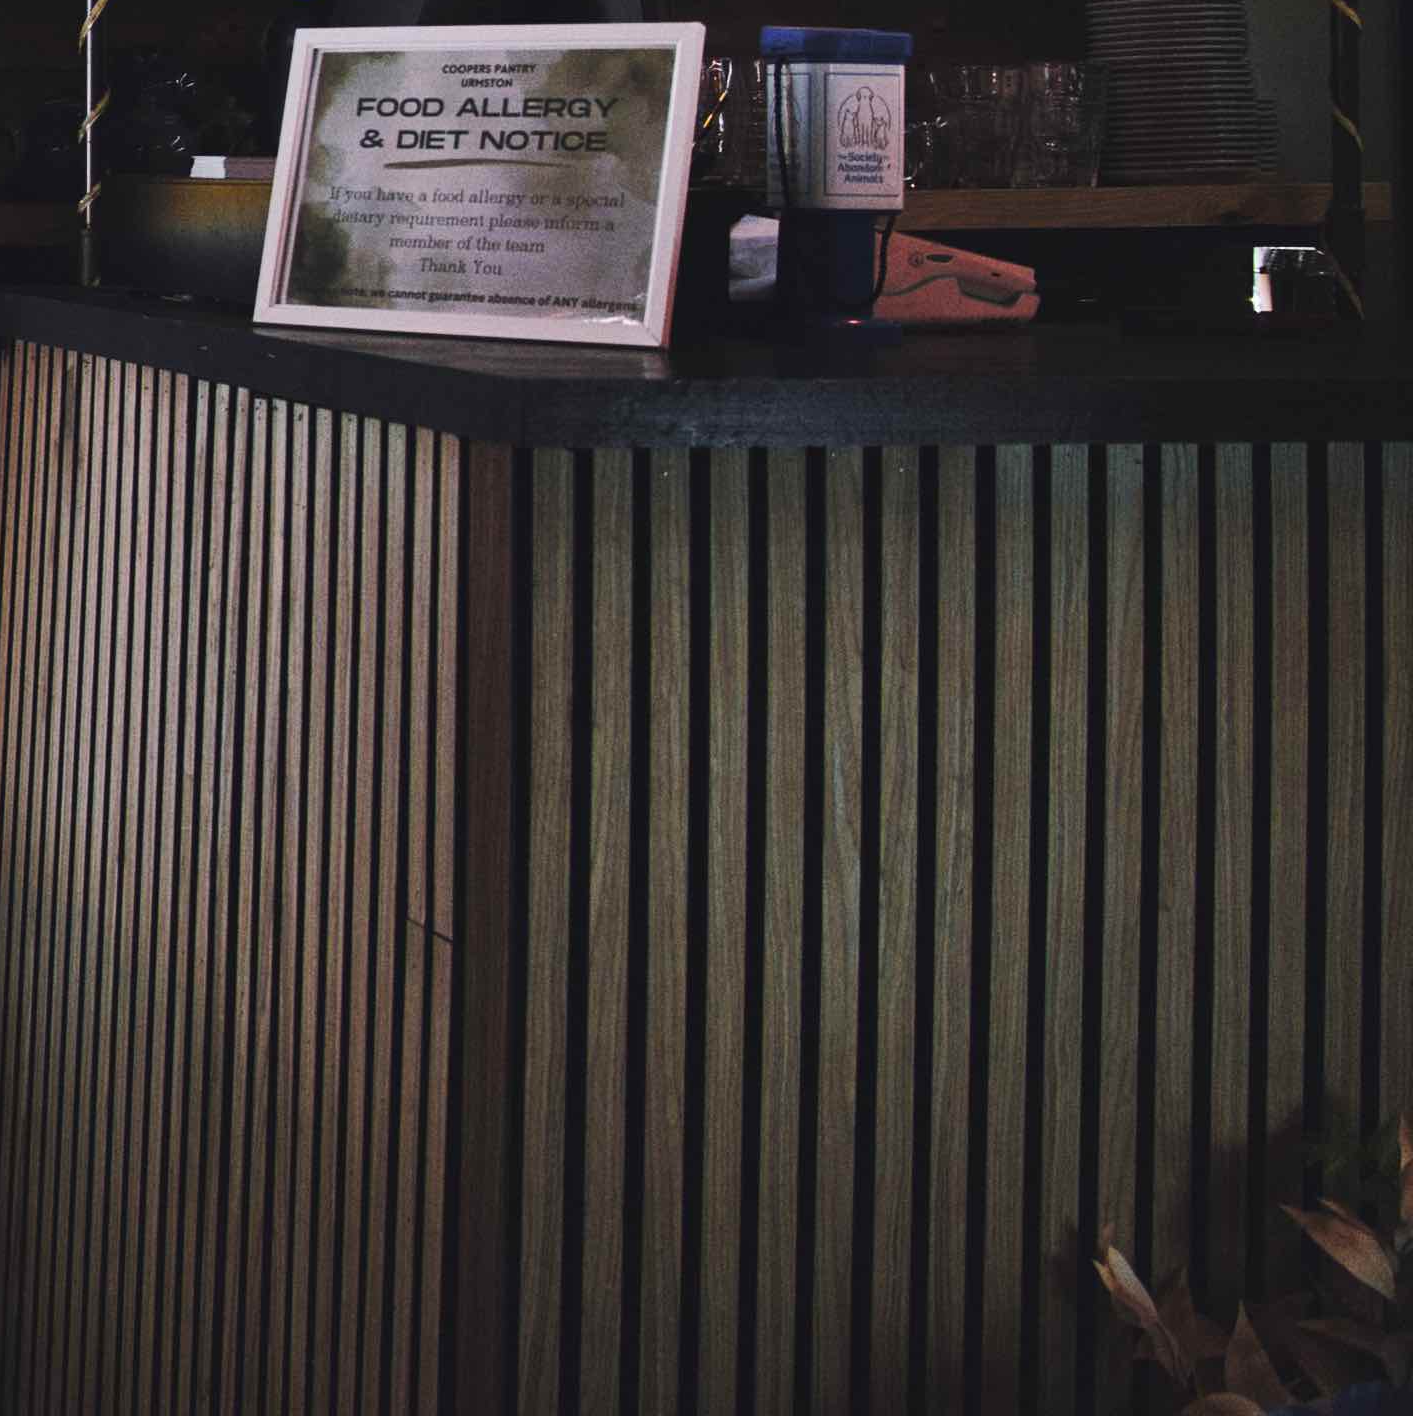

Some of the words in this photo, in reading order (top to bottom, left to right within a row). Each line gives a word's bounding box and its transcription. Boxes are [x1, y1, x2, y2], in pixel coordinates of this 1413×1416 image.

[442, 64, 491, 74] COOPERS
[494, 64, 537, 74] PANTRY
[461, 78, 513, 88] URMSTON
[356, 97, 444, 118] FOOD
[456, 97, 619, 119] ALLERGY
[359, 129, 384, 149] &
[397, 130, 469, 150] DIET
[479, 130, 608, 152] NOTICE
[330, 186, 341, 201] If
[344, 188, 372, 204] you
[376, 186, 414, 202] have
[417, 192, 428, 202] a
[431, 188, 465, 203] food
[469, 190, 526, 209] allergy
[530, 193, 550, 205] or
[552, 194, 562, 205] a
[566, 192, 626, 211] special
[333, 209, 386, 228] dietary
[389, 212, 485, 229] requirement
[488, 215, 541, 232] please
[544, 215, 600, 232] inform
[604, 221, 615, 232] a
[389, 235, 452, 250] member
[457, 236, 475, 251] of
[476, 237, 501, 251] the
[505, 239, 546, 253] team
[419, 257, 467, 274] Thank
[474, 259, 503, 276] You
[388, 288, 426, 301] cannot
[428, 291, 485, 304] guarantee
[488, 294, 536, 305] absence
[538, 294, 552, 306] of
[553, 295, 580, 307] ANY
